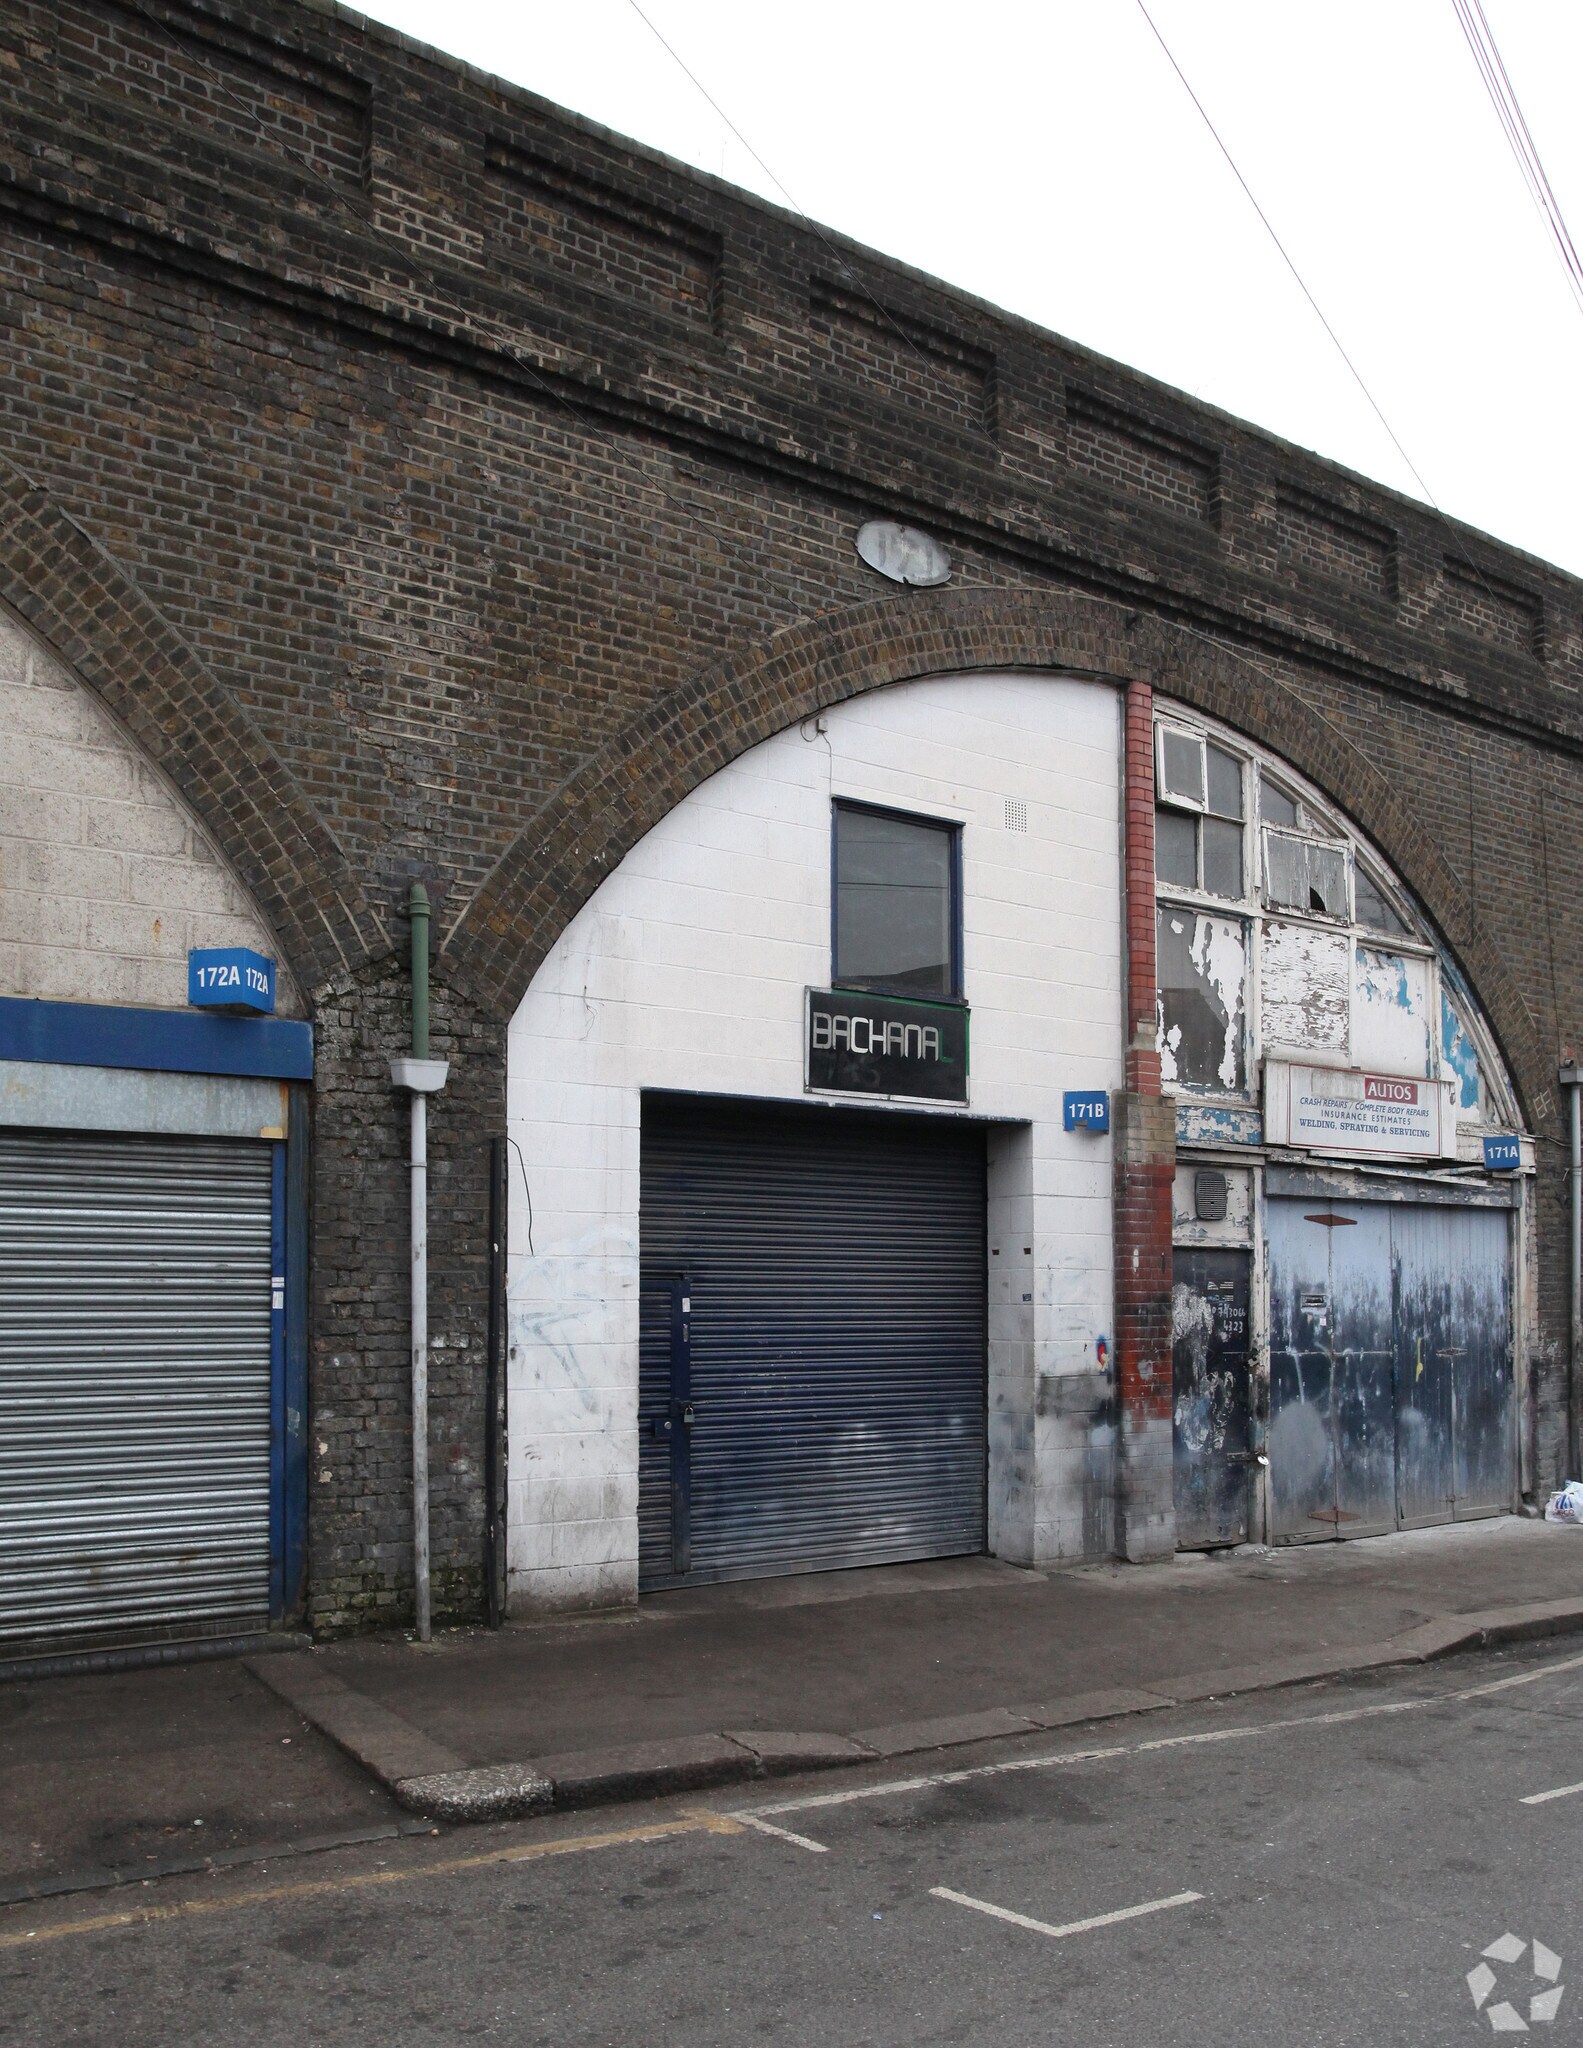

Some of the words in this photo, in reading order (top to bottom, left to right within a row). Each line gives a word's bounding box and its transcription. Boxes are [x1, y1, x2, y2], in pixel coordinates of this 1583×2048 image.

[197, 966, 240, 988] 172A
[246, 967, 269, 995] 172A
[812, 1012, 955, 1063] BACHANAL
[1368, 1082, 1412, 1100] AUTOS
[1069, 1103, 1104, 1118] 171B
[1300, 1097, 1321, 1106] CRASH
[1323, 1099, 1348, 1109] REPAIRS
[1355, 1103, 1386, 1113] COMPLETE
[1387, 1107, 1405, 1115] BODY
[1406, 1108, 1430, 1117] REPAIRS
[1321, 1110, 1367, 1121] INSURANCE
[1371, 1114, 1411, 1125] ESTIMATES
[1299, 1119, 1338, 1130] WELDING,
[1340, 1122, 1379, 1133] SPRAYING
[1381, 1126, 1387, 1134] &
[1389, 1127, 1430, 1137] SERVICING
[1488, 1146, 1518, 1159] 171A
